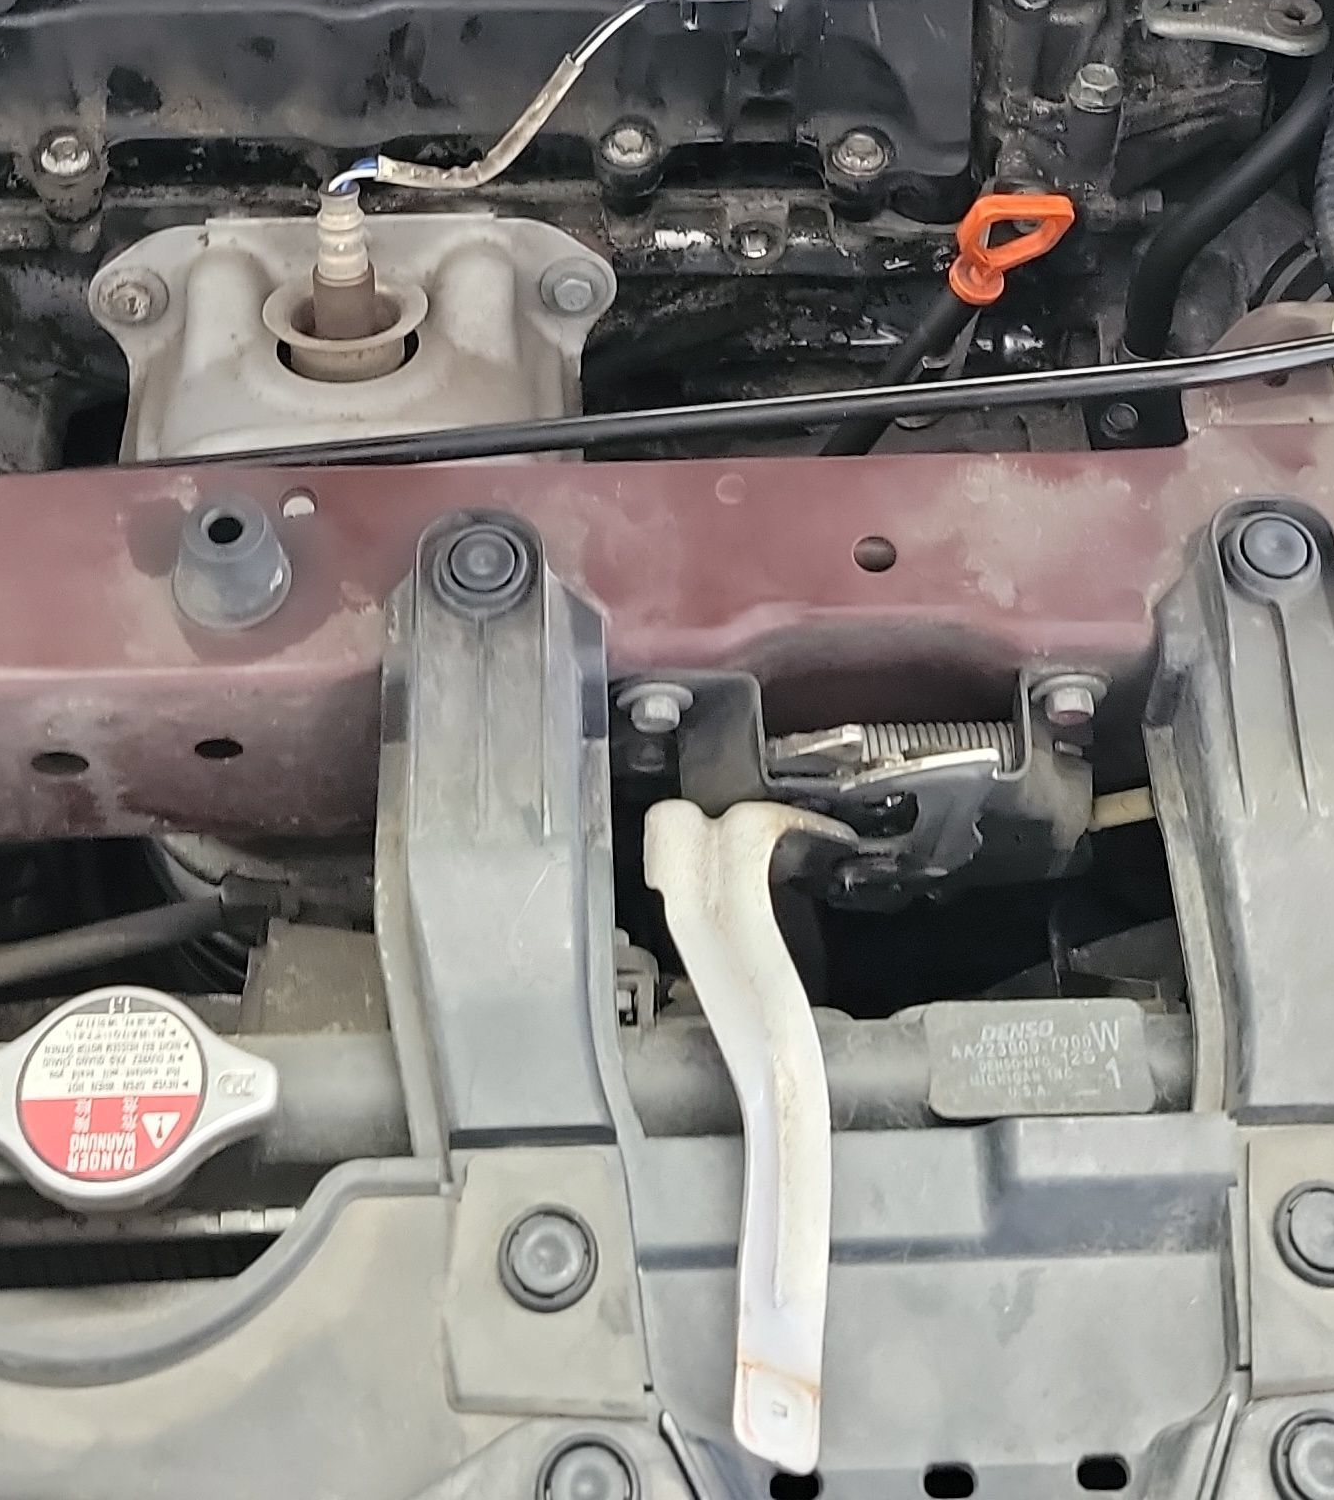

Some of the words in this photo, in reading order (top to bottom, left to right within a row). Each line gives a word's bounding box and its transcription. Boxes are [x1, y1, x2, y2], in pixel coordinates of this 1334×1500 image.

[981, 1020, 1054, 1042] DENSO
[69, 1131, 135, 1151] WARNUNG
[66, 1151, 135, 1171] DANGER
